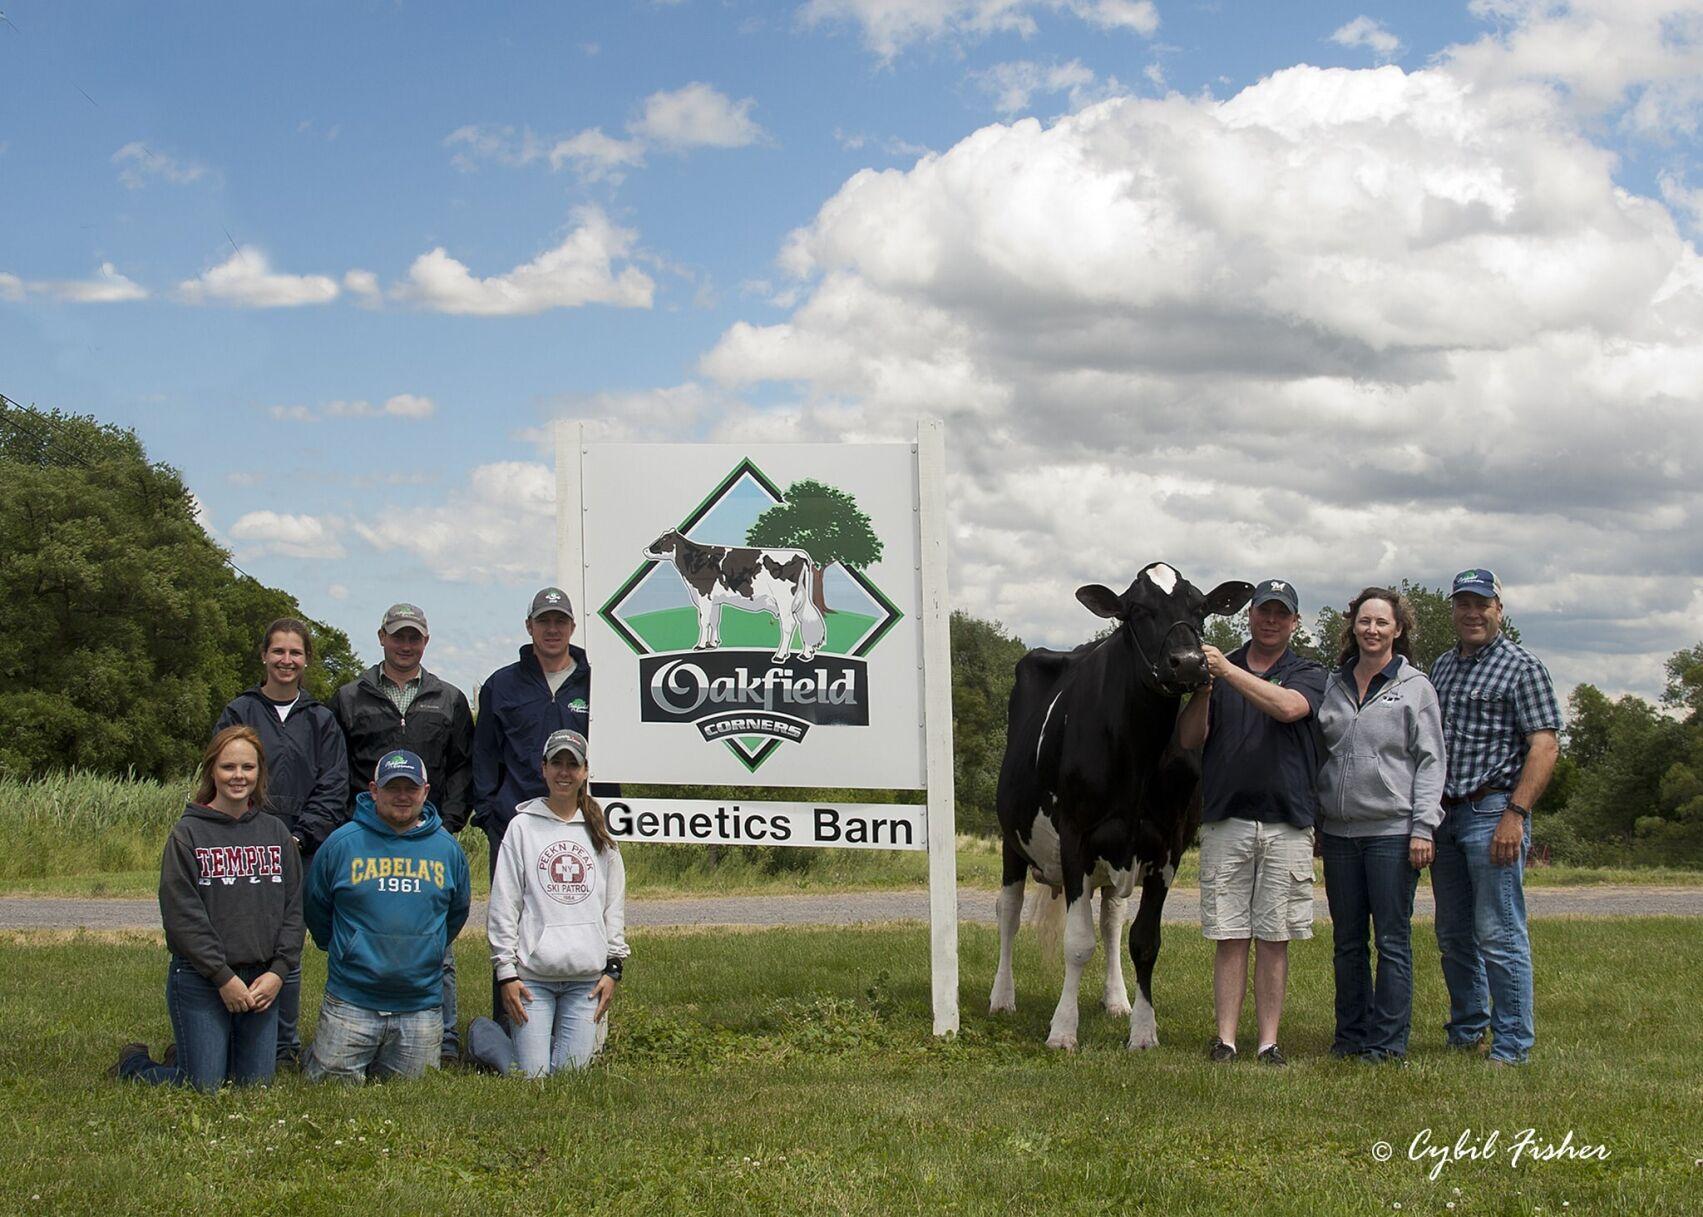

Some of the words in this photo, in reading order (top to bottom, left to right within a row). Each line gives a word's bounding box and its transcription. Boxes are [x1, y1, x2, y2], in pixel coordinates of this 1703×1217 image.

[651, 659, 857, 714] Oakfield
[704, 718, 802, 738] CORNERS
[604, 802, 791, 841] Genetics
[813, 808, 912, 844] Barn
[195, 845, 282, 877] TEMPLE
[561, 865, 572, 873] NY
[572, 844, 594, 871] PEAK
[351, 857, 445, 889] CABELA'S
[378, 877, 421, 893] 1961
[547, 884, 560, 893] SKI
[562, 884, 590, 893] PATROL
